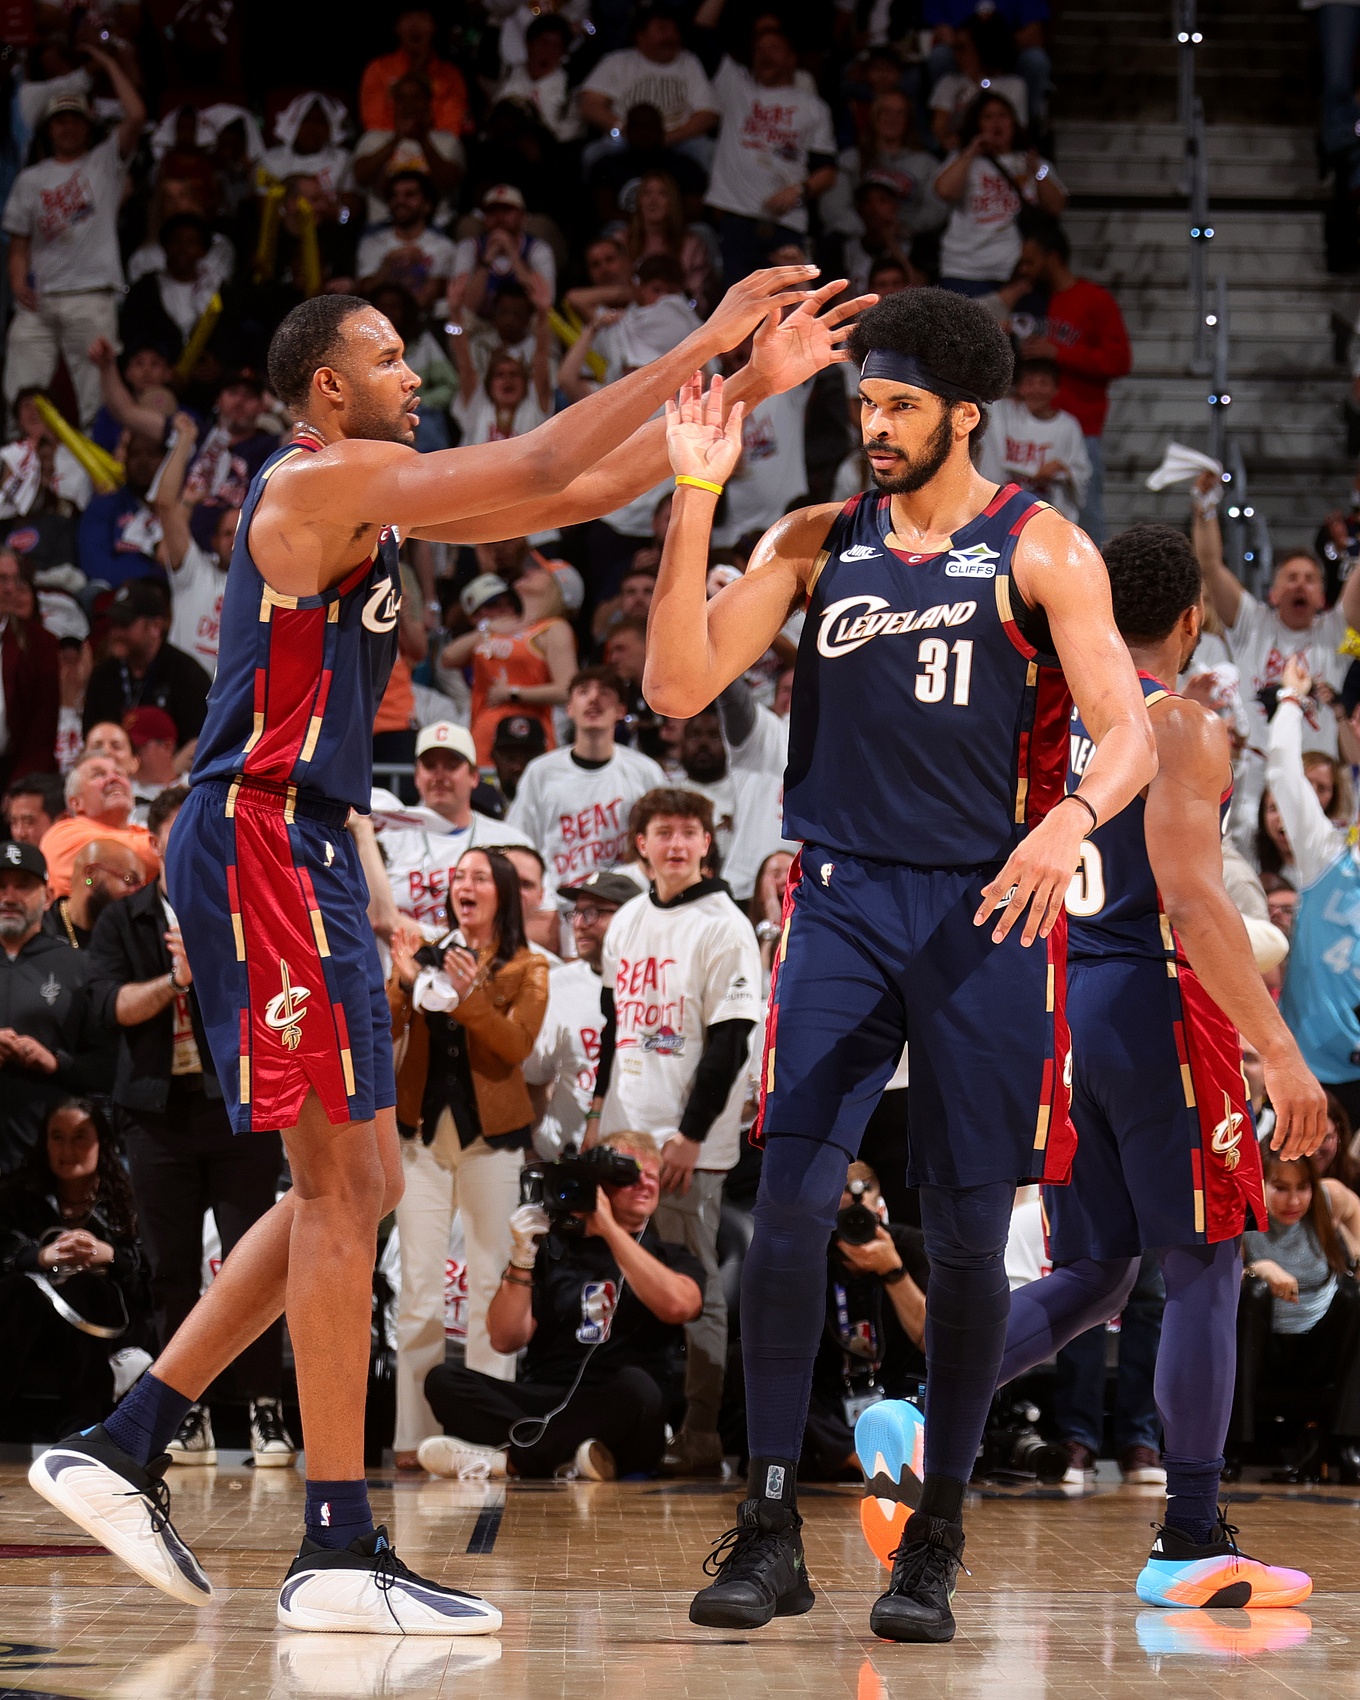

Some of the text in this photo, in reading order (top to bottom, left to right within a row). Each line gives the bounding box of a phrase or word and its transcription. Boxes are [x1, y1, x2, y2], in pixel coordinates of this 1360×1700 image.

[848, 544, 877, 557] NIKE
[948, 565, 994, 575] CLIFFS
[817, 595, 977, 658] CLEVELAND
[914, 637, 973, 706] 31
[560, 797, 623, 845] BEAT
[616, 957, 677, 996] BEAT
[615, 995, 685, 1032] ETROIT!
